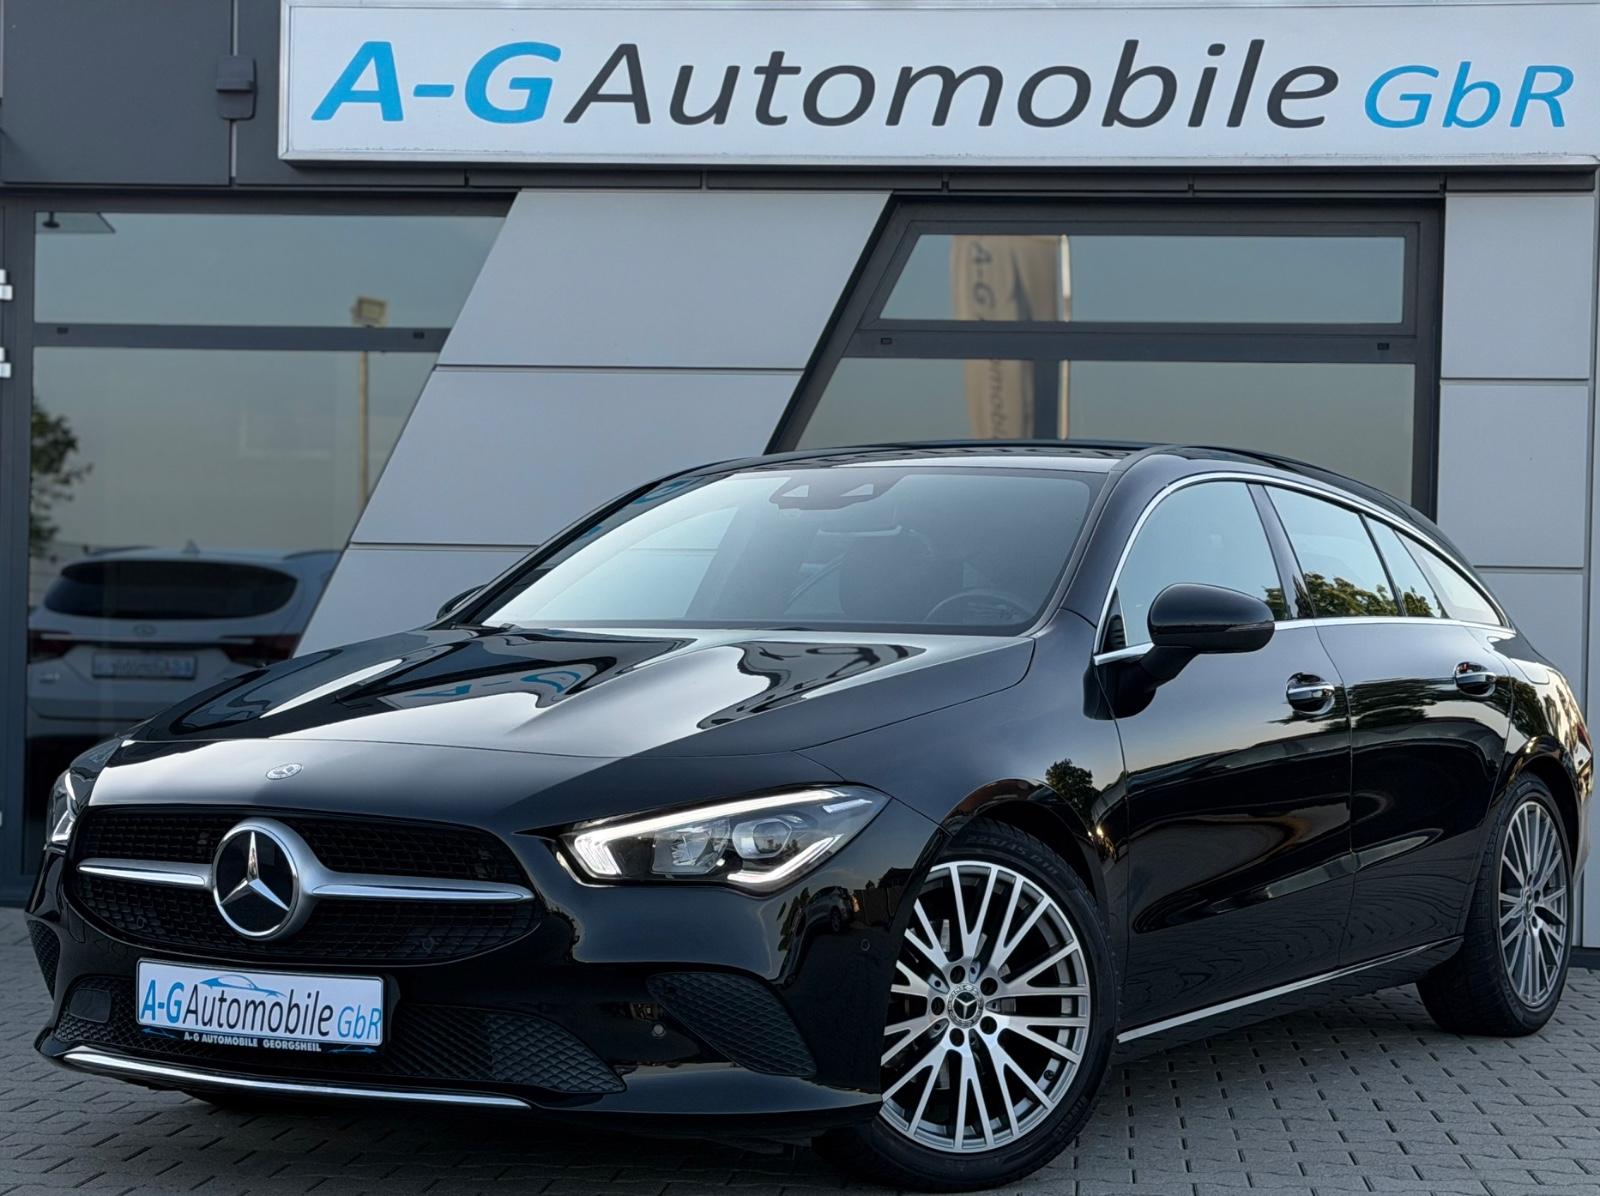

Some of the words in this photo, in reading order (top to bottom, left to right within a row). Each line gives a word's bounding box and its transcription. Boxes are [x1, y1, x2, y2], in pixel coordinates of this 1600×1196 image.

[311, 41, 562, 125] A-G
[562, 39, 1339, 128] Automobile
[1364, 60, 1575, 129] GbR
[140, 979, 185, 1024] A-G
[183, 983, 333, 1036] Automobile
[337, 1004, 382, 1040] GbR
[184, 1031, 200, 1042] A-G
[201, 1034, 259, 1048] AUTOMOBILE
[263, 1038, 322, 1052] GEORGSHEIL
